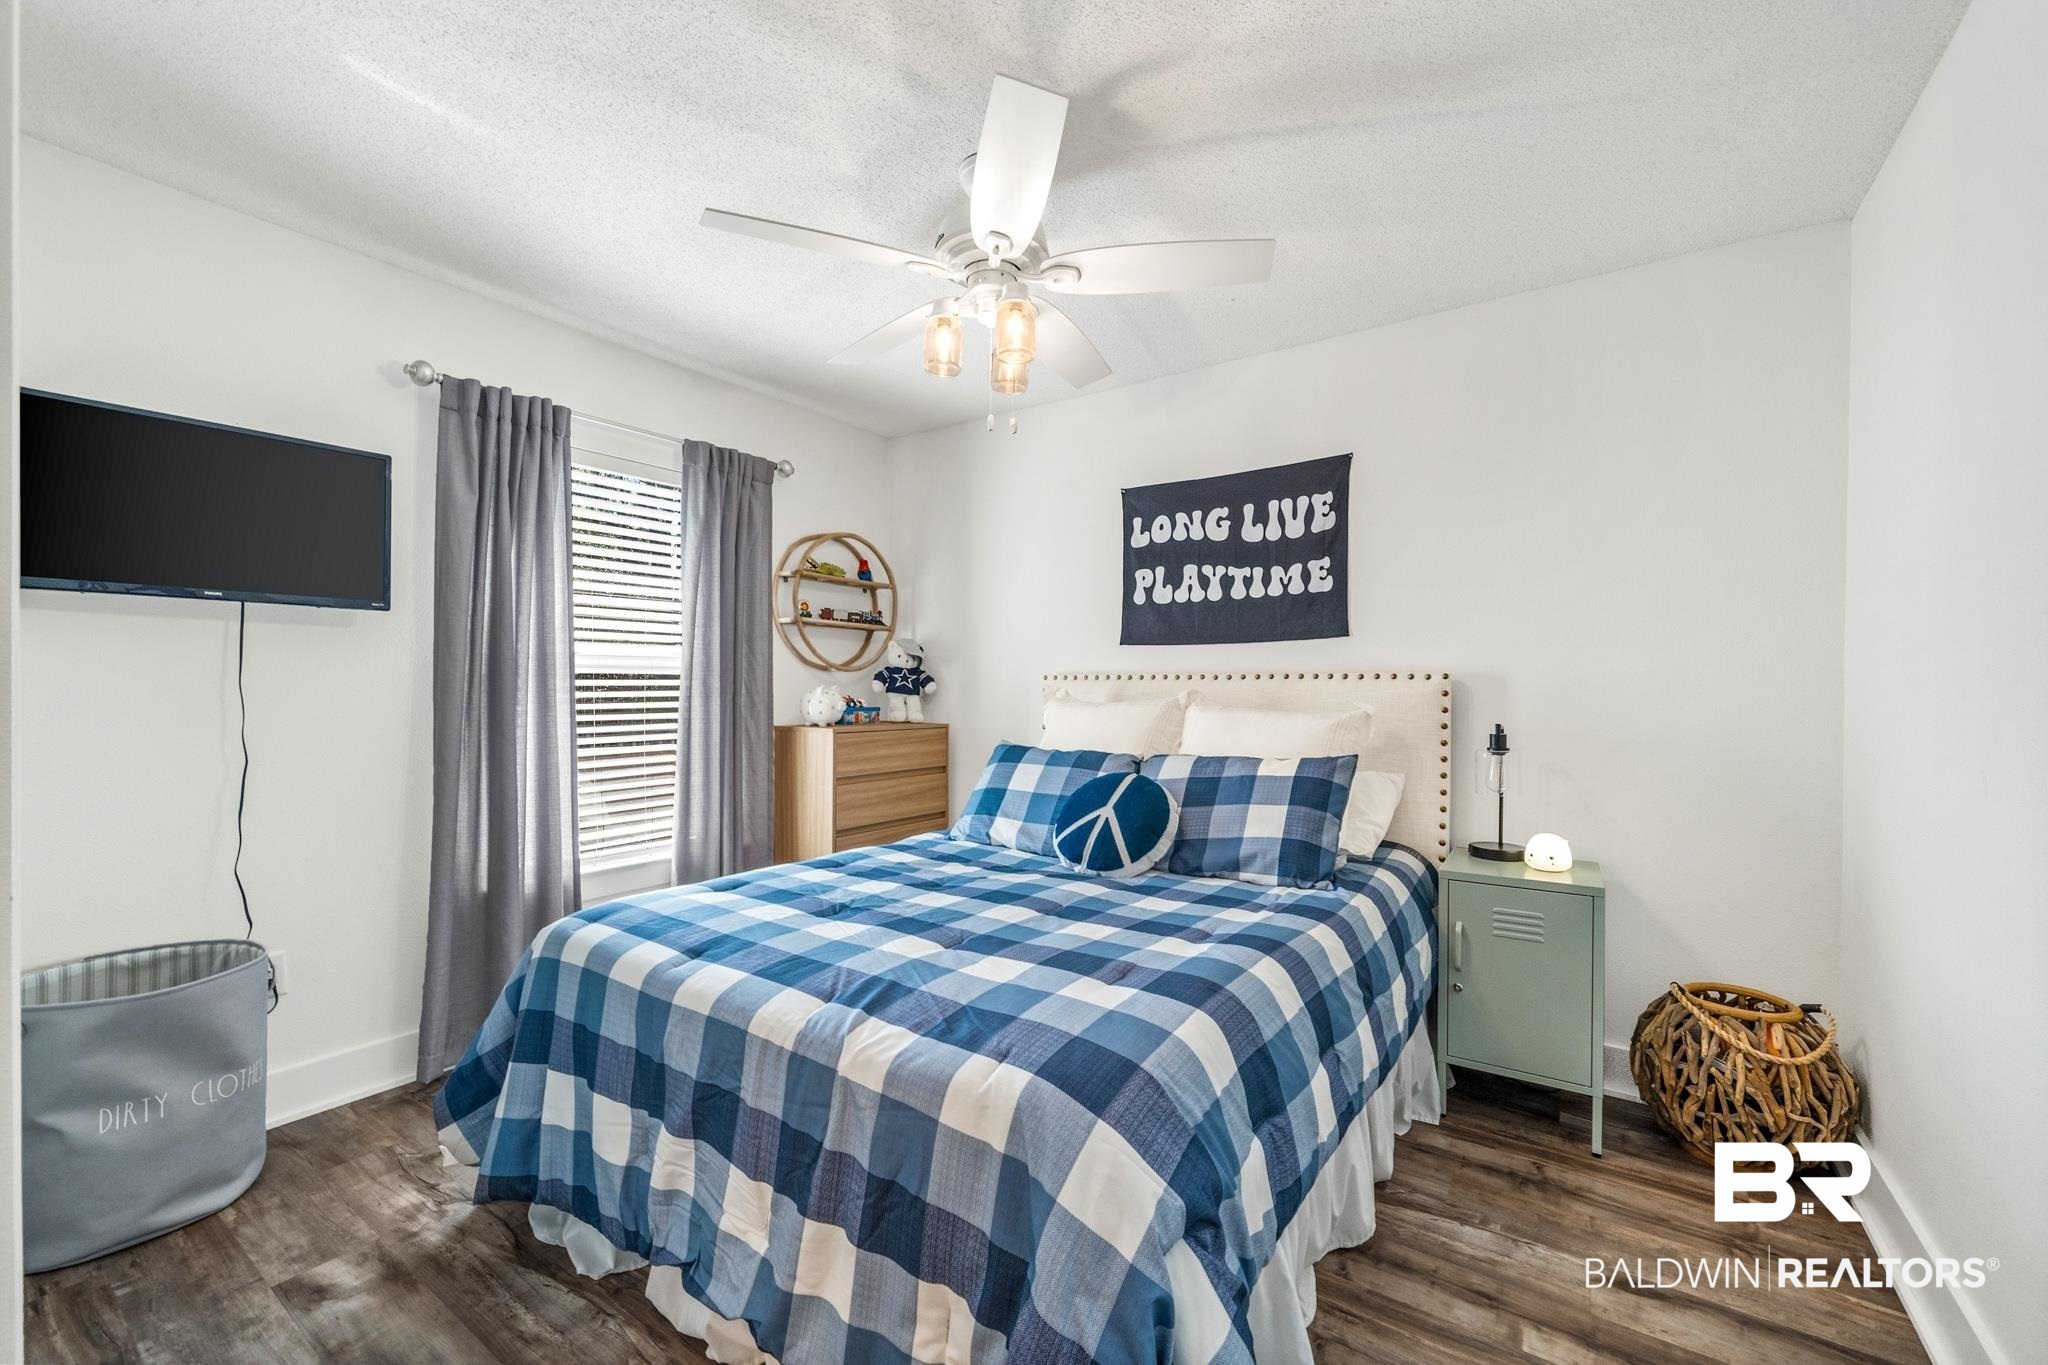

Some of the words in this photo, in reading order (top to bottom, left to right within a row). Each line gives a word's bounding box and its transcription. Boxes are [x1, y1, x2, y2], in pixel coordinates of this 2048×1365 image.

[1130, 506, 1231, 548] LONG
[1241, 490, 1336, 543] LIVE
[1133, 556, 1334, 605] PLAYTIME
[99, 1092, 169, 1135] DIRTY
